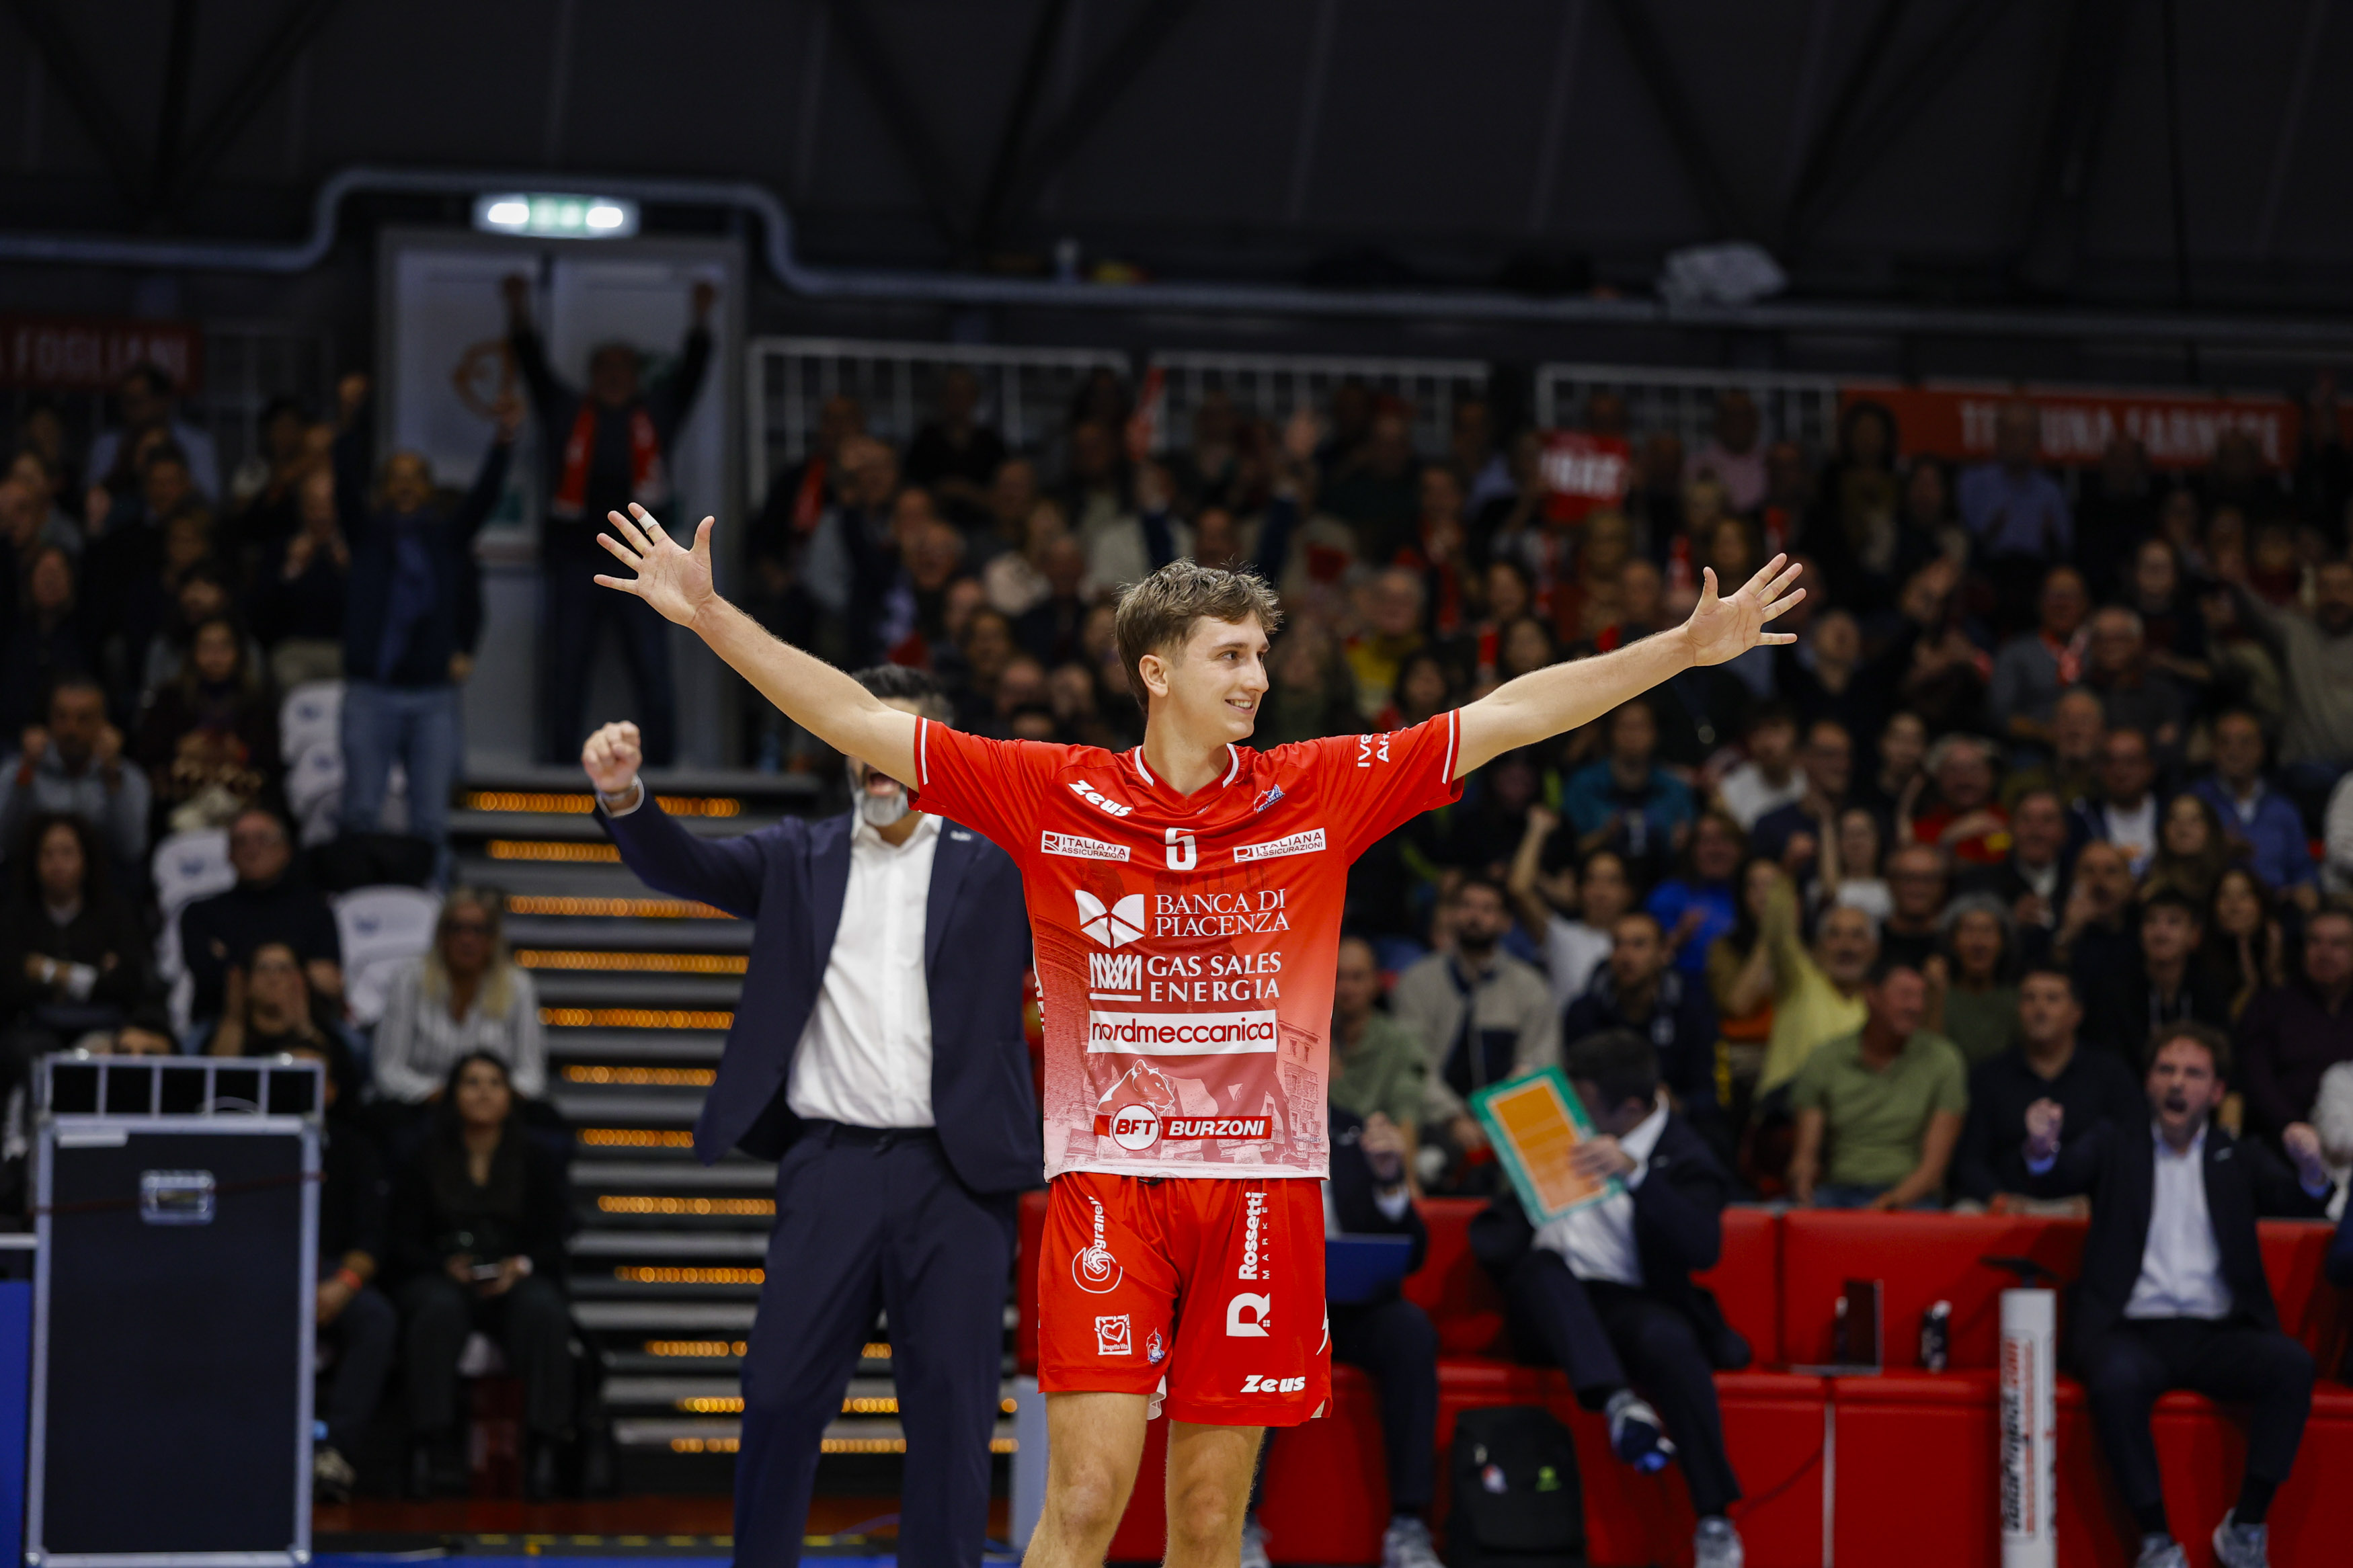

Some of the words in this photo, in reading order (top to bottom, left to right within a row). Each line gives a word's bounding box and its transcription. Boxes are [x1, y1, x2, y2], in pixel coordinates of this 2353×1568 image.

[1068, 780, 1133, 817] Zeus
[1062, 837, 1126, 857] ITALIANA
[1062, 847, 1126, 859] ASSICURAZIONI
[1256, 832, 1322, 855] ITALIANA
[1257, 841, 1323, 857] ASSICURAZIONI
[1154, 893, 1251, 915] BANCA
[1257, 889, 1286, 911] DI
[1154, 911, 1290, 937] PIACENZA
[1147, 956, 1202, 977] GAS
[1210, 952, 1282, 976] SALES
[1150, 978, 1280, 1002] ENERGIA
[1092, 1017, 1274, 1042] nordmeccanica
[1115, 1118, 1156, 1135] BFT
[1168, 1120, 1265, 1136] BURZONI
[1238, 1192, 1264, 1280] Rossetti
[1262, 1191, 1270, 1280] MARKET
[1240, 1374, 1306, 1393] Zeus
